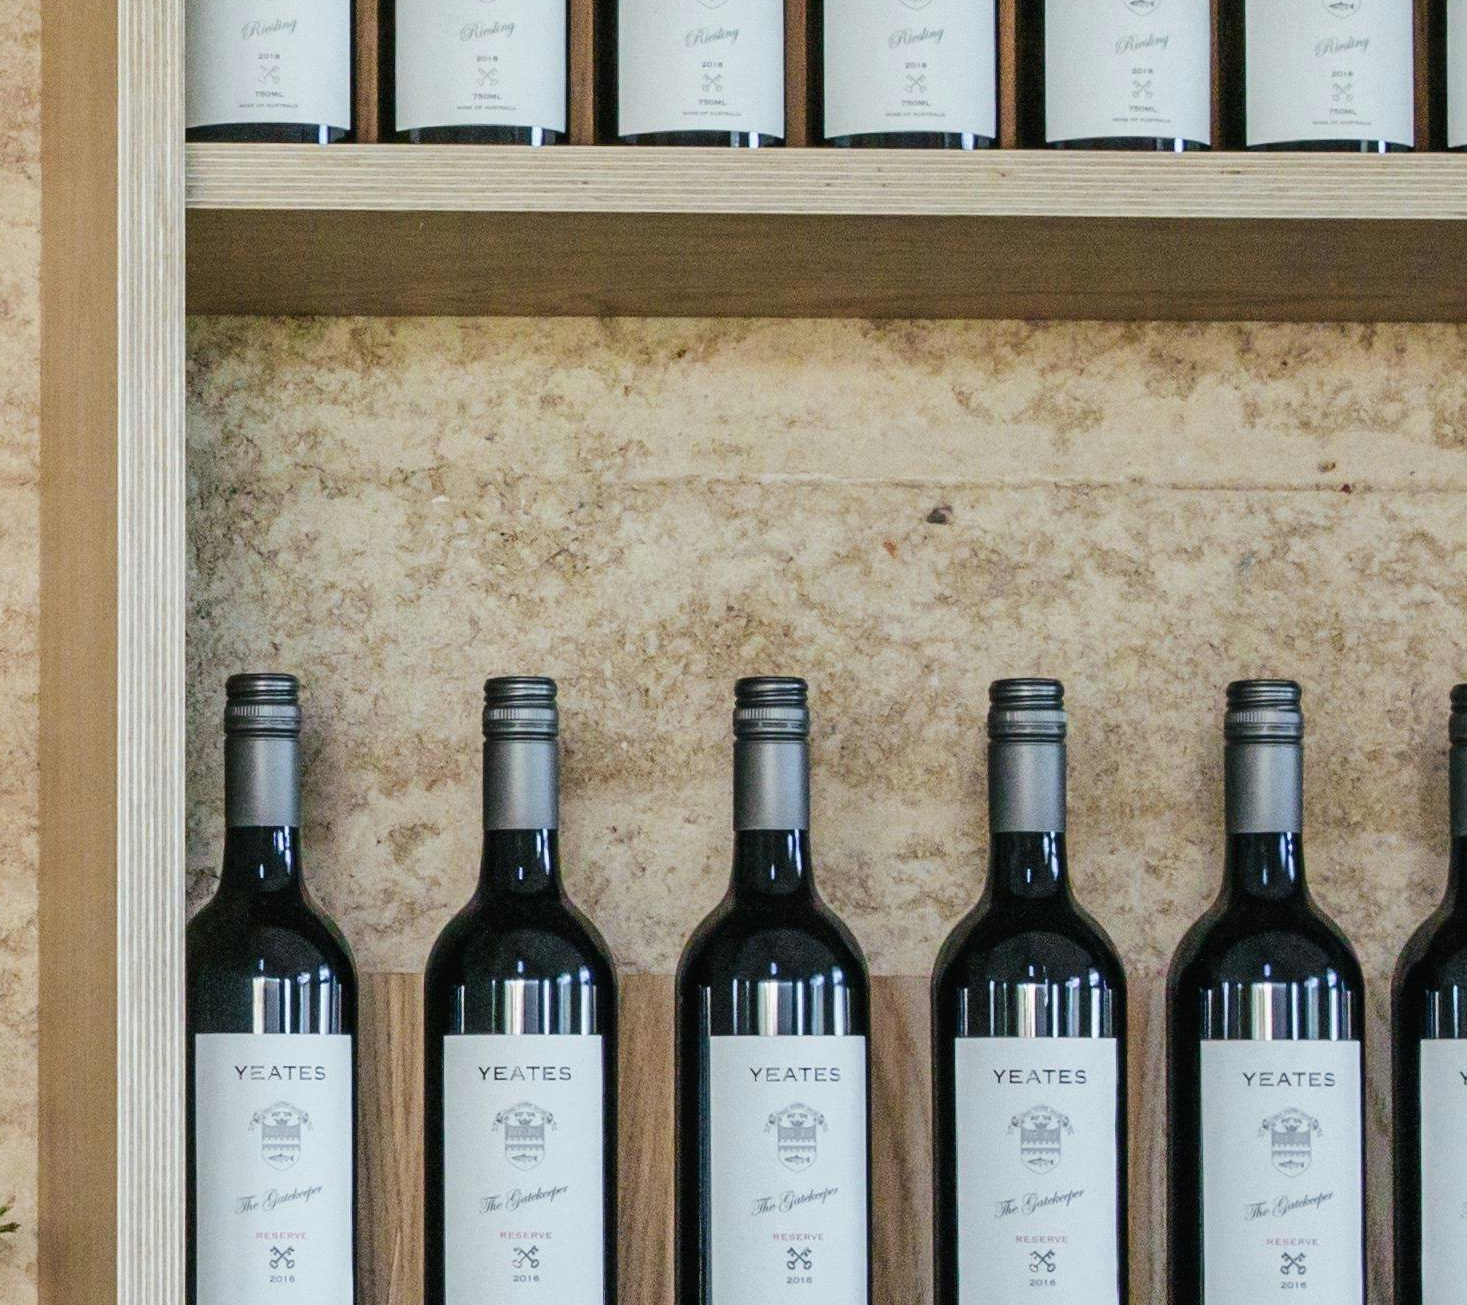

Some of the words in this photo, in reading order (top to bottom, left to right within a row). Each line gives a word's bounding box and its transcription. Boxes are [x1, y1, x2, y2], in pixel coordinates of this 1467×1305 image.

[242, 18, 297, 40] Riesling
[460, 21, 515, 42] Riesling
[685, 27, 740, 48] Riesling
[888, 27, 944, 49] Riesling
[1115, 33, 1169, 55] Riesling
[1315, 36, 1370, 58] Riesling
[235, 1065, 327, 1081] YEATES
[479, 1066, 572, 1081] YEATES
[750, 1067, 842, 1082] YEATES
[994, 1069, 1087, 1085] YEATES
[1244, 1072, 1336, 1087] YEATES
[236, 1195, 260, 1215] The
[262, 1186, 323, 1212] Gatekeeper
[479, 1195, 503, 1215] The
[506, 1186, 568, 1212] Gatekeeper
[752, 1196, 776, 1217] The
[779, 1187, 840, 1214] Gatekeeper
[994, 1198, 1019, 1219] The
[1022, 1190, 1085, 1216] Gatekeeper
[1246, 1201, 1270, 1222] The
[1272, 1192, 1335, 1219] Gatekeeper
[256, 1232, 308, 1240] RESERVE
[773, 1233, 824, 1241] RESERVE
[1267, 1238, 1319, 1246] RESERVE
[269, 1275, 296, 1284] 2016
[513, 1275, 540, 1283] 2016
[786, 1276, 813, 1285] 2016
[1029, 1279, 1057, 1287] 2016
[1280, 1281, 1307, 1290] 2016
